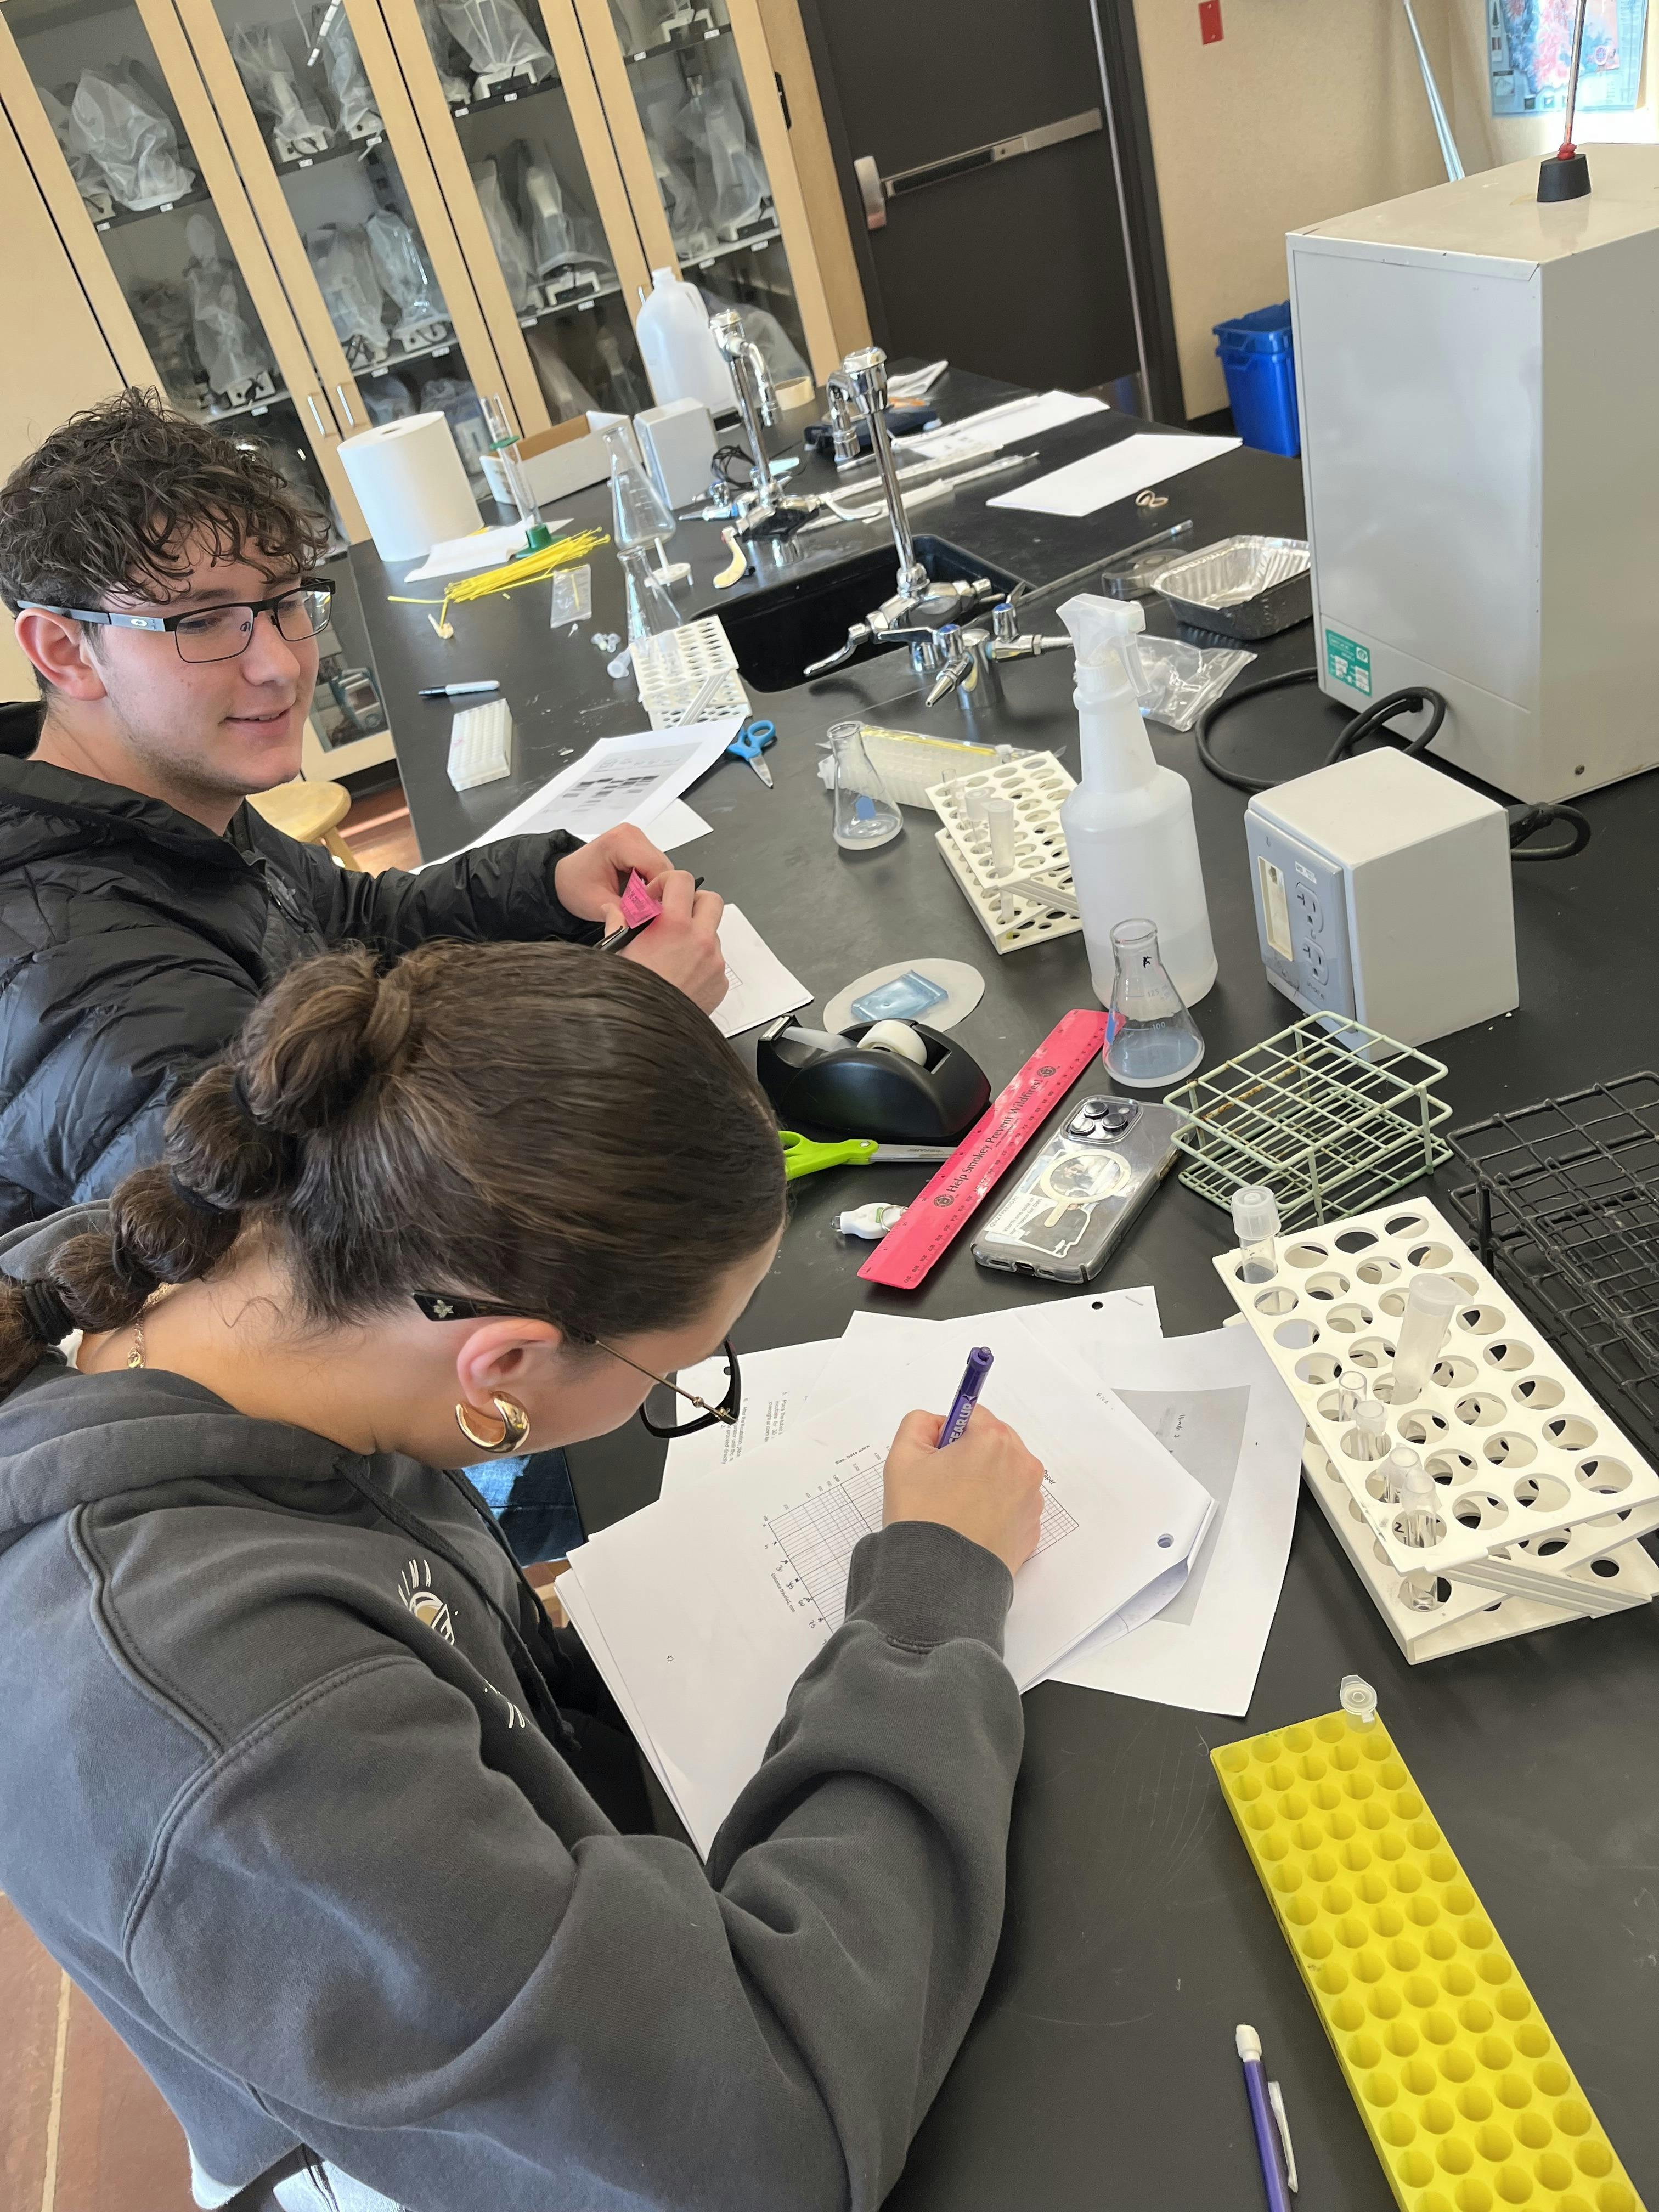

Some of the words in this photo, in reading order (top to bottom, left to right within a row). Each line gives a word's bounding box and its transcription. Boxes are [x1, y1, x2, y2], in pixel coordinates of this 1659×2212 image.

[1152, 1022, 1166, 1030] 100
[946, 1175, 969, 1192] Help
[962, 1145, 992, 1173] Smokey
[986, 1116, 1013, 1143] Prevent
[1008, 1079, 1043, 1114] Wildfires!
[990, 1215, 1001, 1227] QUIZ
[1003, 1218, 1016, 1232] Worth
[961, 1403, 973, 1419] UP
[858, 1444, 870, 1453] pairs
[1394, 1522, 1404, 1533] 2
[770, 1573, 782, 1589] Distance
[780, 1588, 791, 1606] traveled,
[788, 1604, 796, 1613] mm
